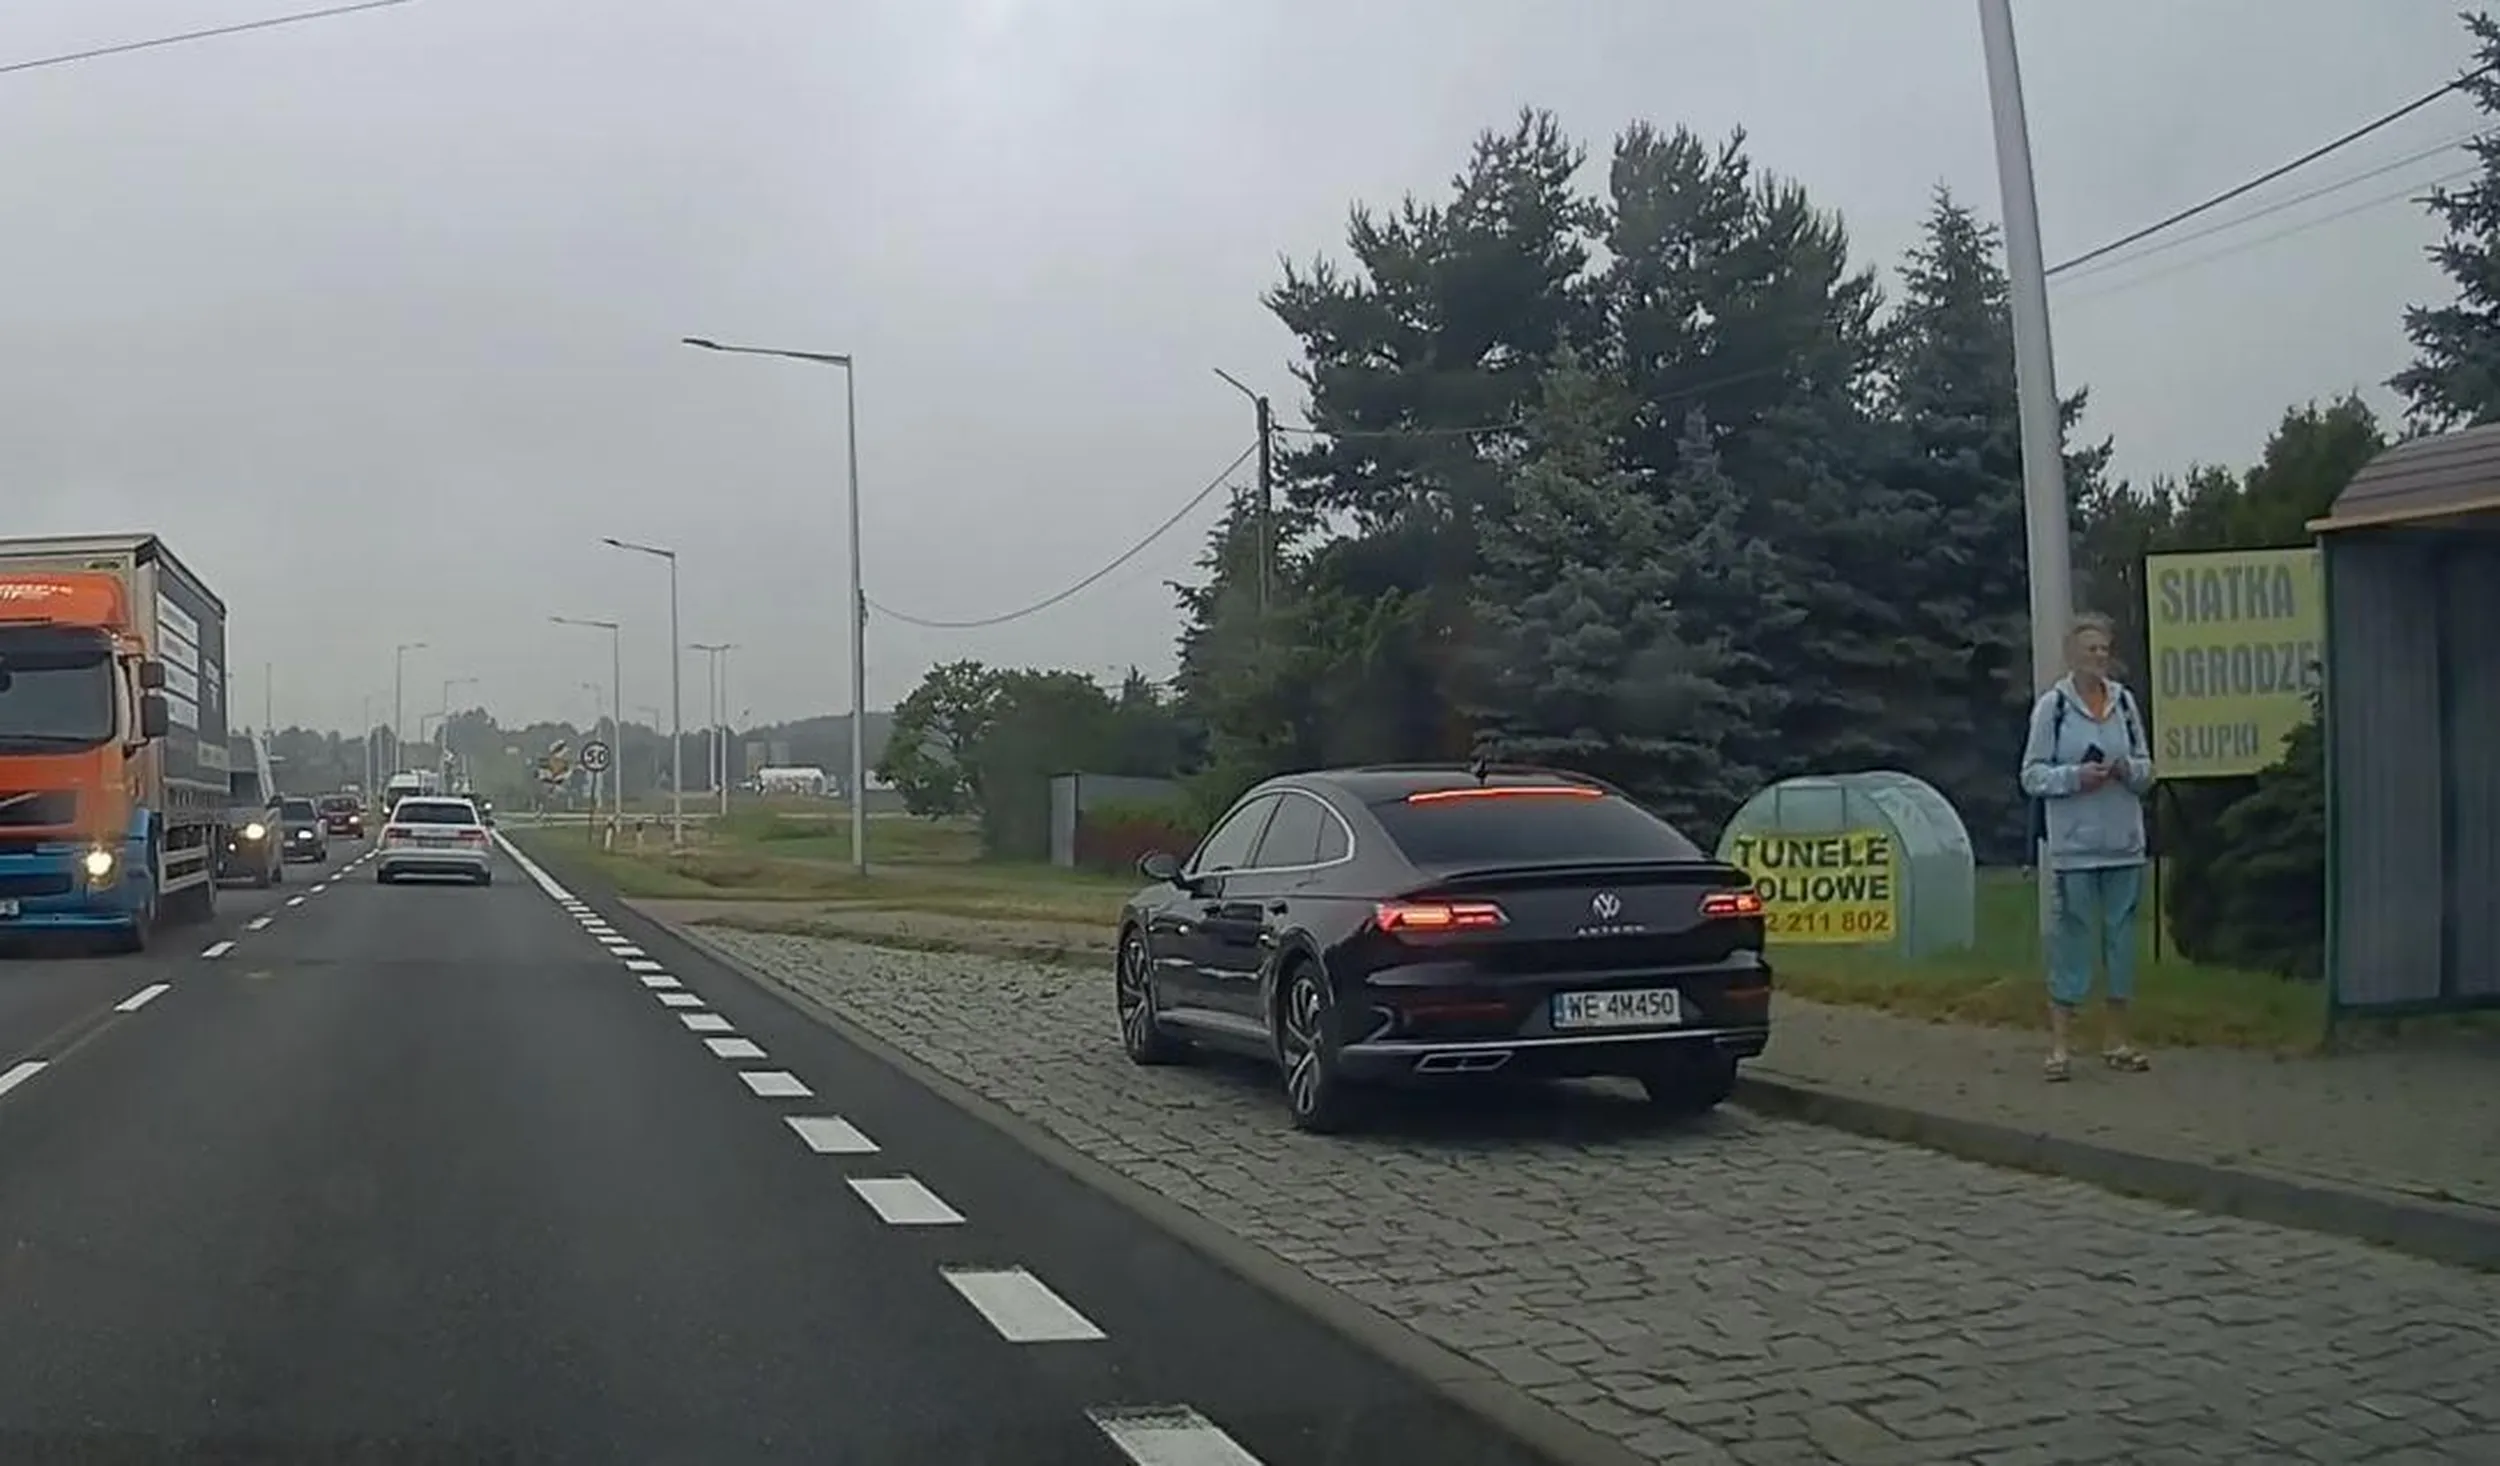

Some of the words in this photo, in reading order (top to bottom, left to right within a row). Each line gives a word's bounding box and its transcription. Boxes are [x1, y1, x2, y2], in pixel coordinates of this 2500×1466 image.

[2159, 564, 2295, 625] SIATKA
[2161, 641, 2323, 699] OGRODZE
[586, 748, 609, 765] 50
[1734, 836, 1890, 868] TUNELE
[1756, 875, 1890, 902] OLIOWE
[1786, 911, 1831, 933] 211
[1841, 910, 1890, 933] 802
[1568, 994, 1600, 1020] WE
